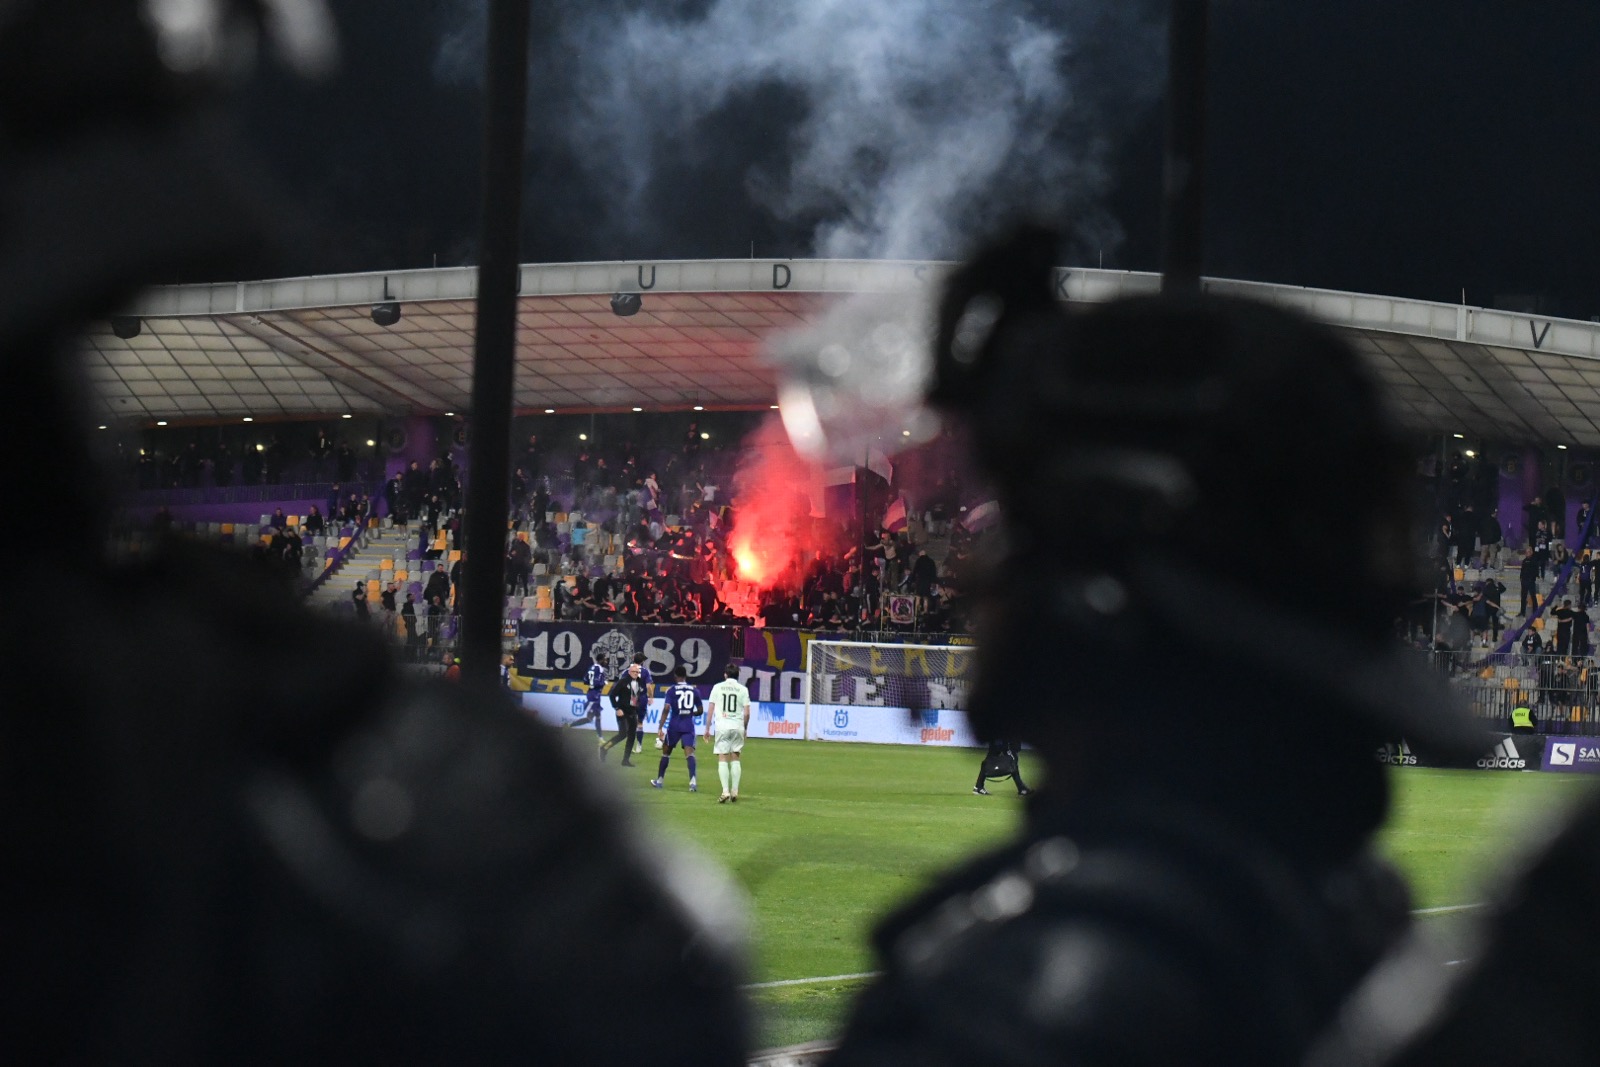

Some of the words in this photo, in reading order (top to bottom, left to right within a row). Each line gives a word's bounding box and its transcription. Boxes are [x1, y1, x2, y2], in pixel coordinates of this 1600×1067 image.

[675, 690, 694, 709] 70
[722, 693, 738, 713] 10
[767, 719, 801, 736] geder
[921, 727, 955, 743] geder
[1476, 757, 1526, 769] adidas
